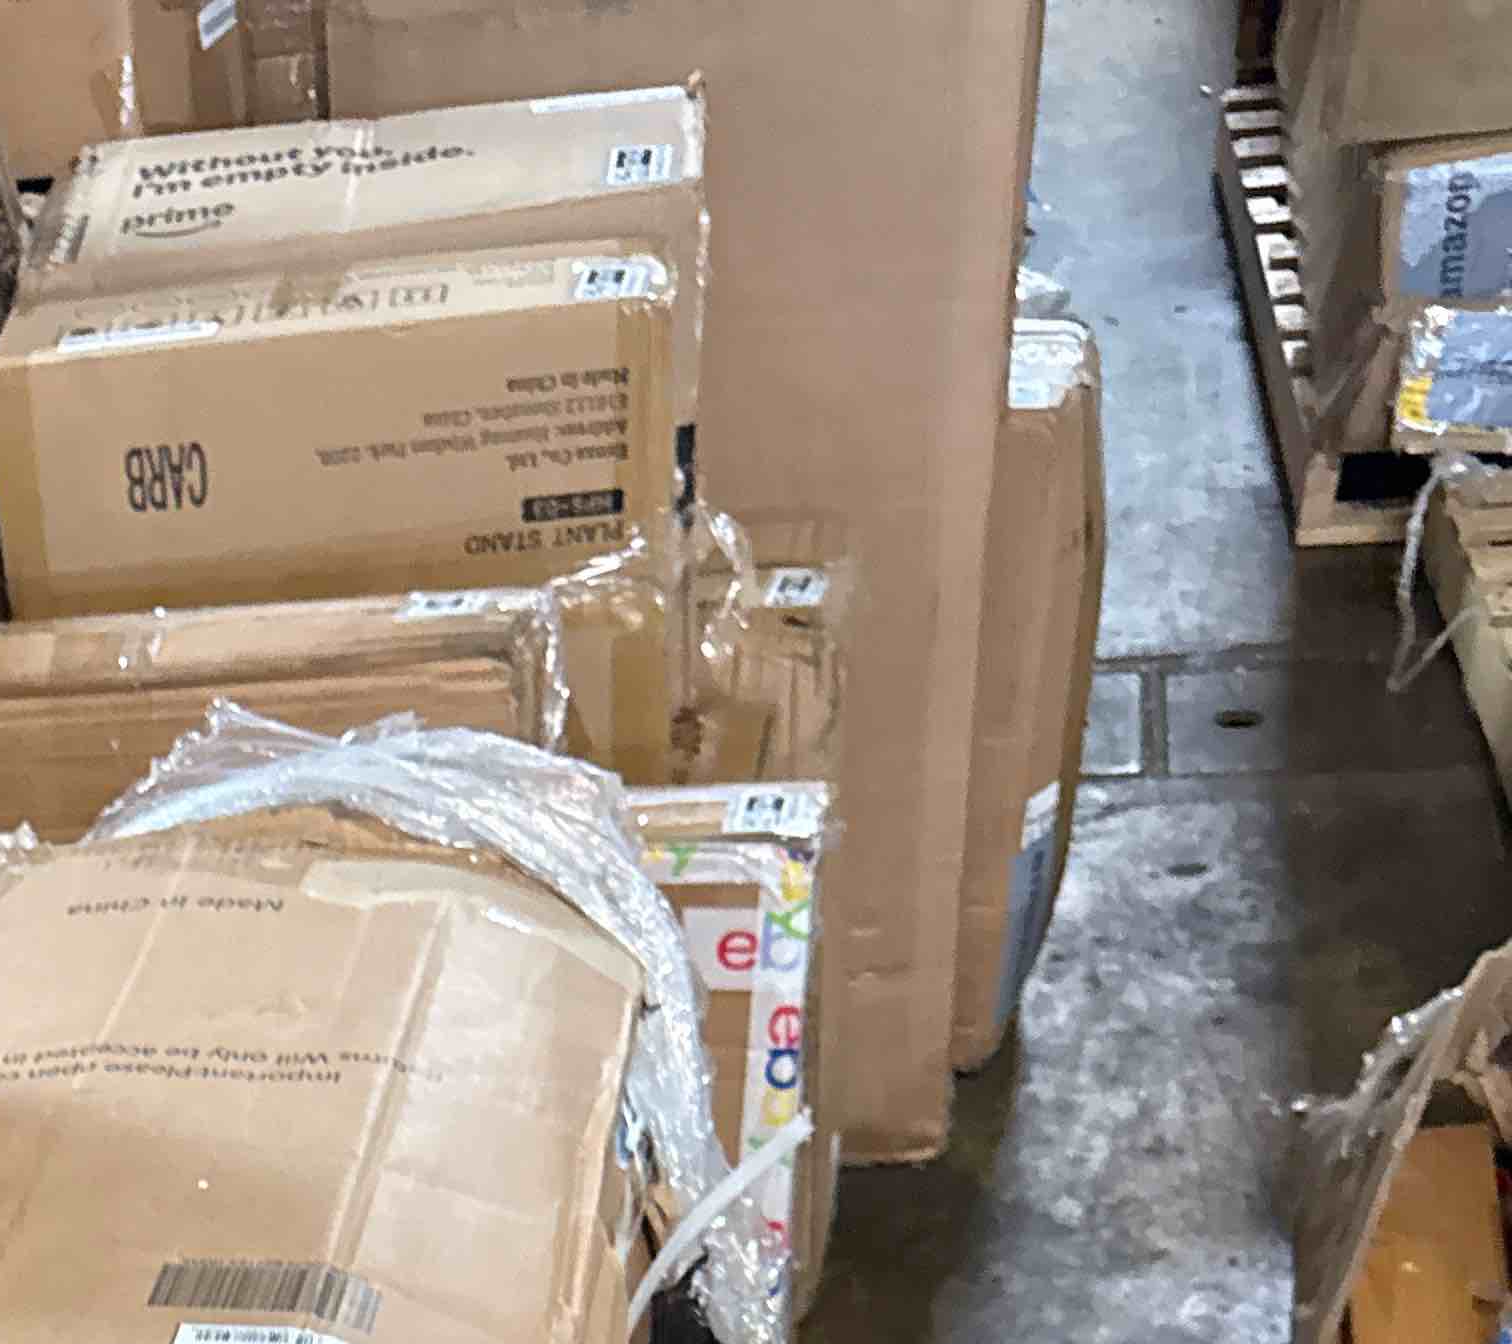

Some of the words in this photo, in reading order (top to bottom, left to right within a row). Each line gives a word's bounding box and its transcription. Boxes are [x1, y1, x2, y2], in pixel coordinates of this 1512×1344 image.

[133, 176, 191, 199] I'm
[201, 160, 332, 187] empty
[342, 145, 476, 174] inside.
[140, 148, 301, 181] Without
[121, 201, 236, 235] prime
[126, 440, 208, 515] CARB
[464, 529, 543, 556] STAND
[552, 519, 625, 550] PLANT
[66, 898, 152, 917] China
[160, 897, 190, 914] in
[197, 896, 285, 915] Made
[163, 1046, 201, 1062] be
[205, 1045, 269, 1066] only
